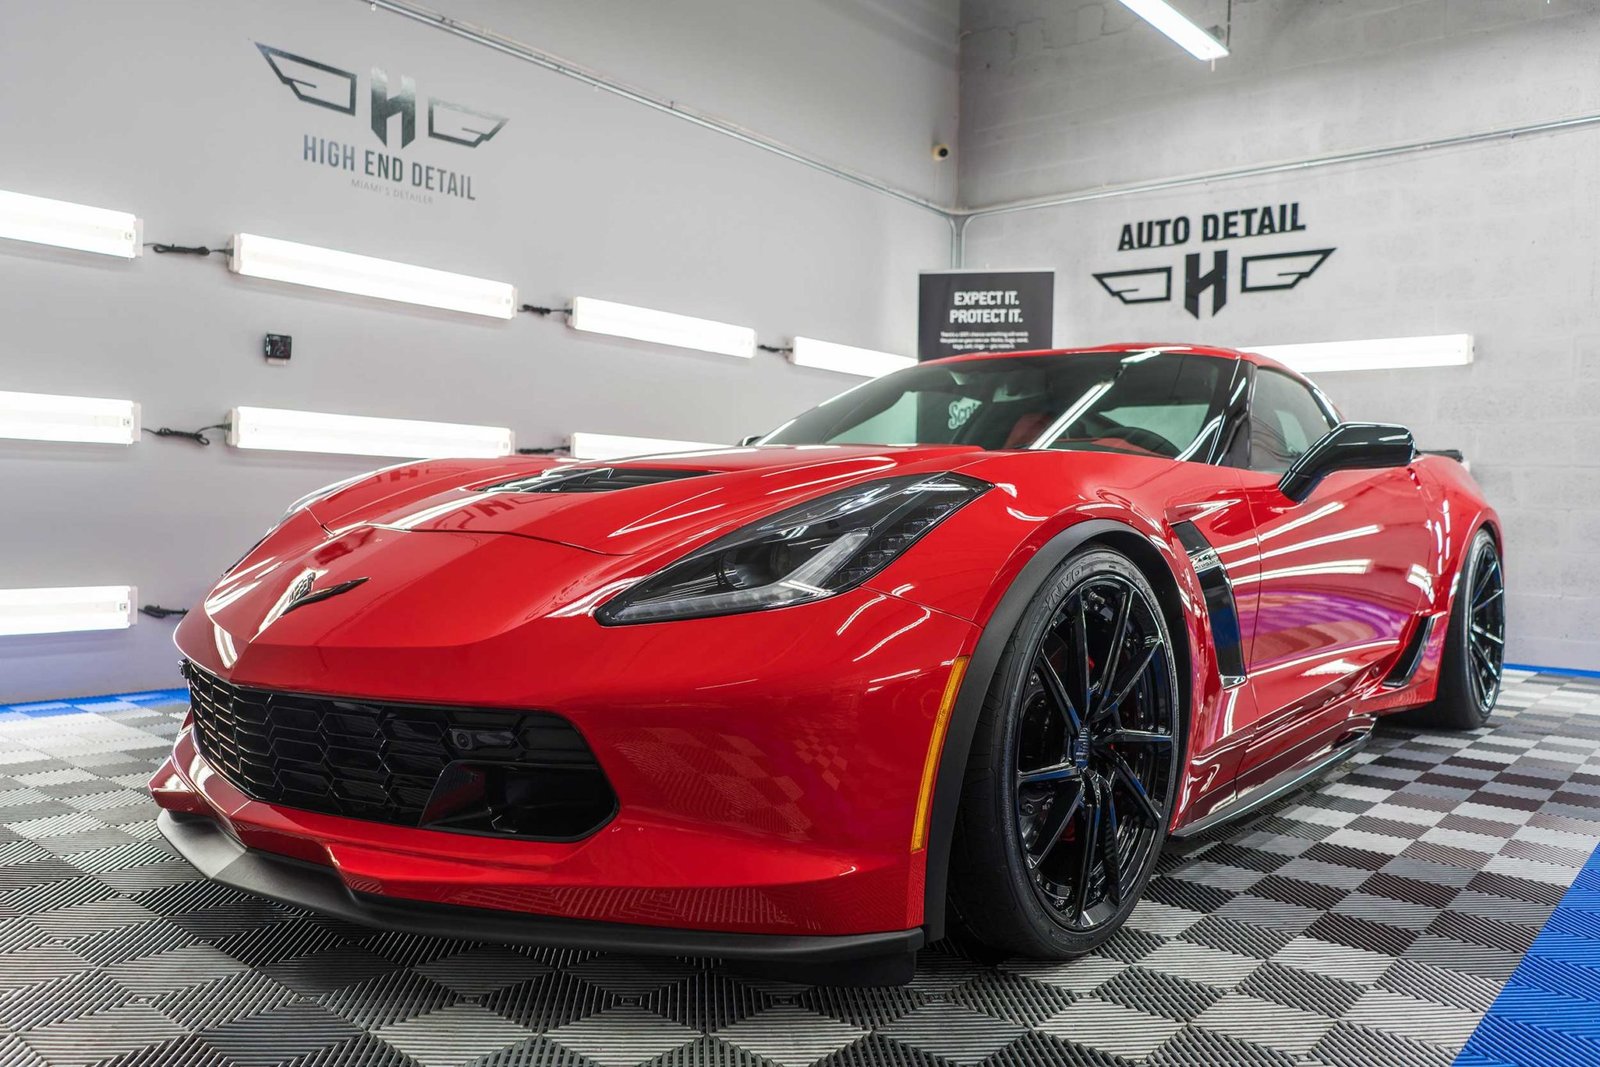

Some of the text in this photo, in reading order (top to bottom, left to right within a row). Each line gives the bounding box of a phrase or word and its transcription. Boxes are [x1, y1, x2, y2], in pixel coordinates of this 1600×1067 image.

[303, 134, 476, 201] HIGH END DETAIL
[393, 189, 434, 205] DETAILER
[1118, 202, 1306, 251] AUTO DETAIL
[953, 290, 1020, 306] EXPECT IT.
[949, 308, 1023, 324] PROTECT IT.
